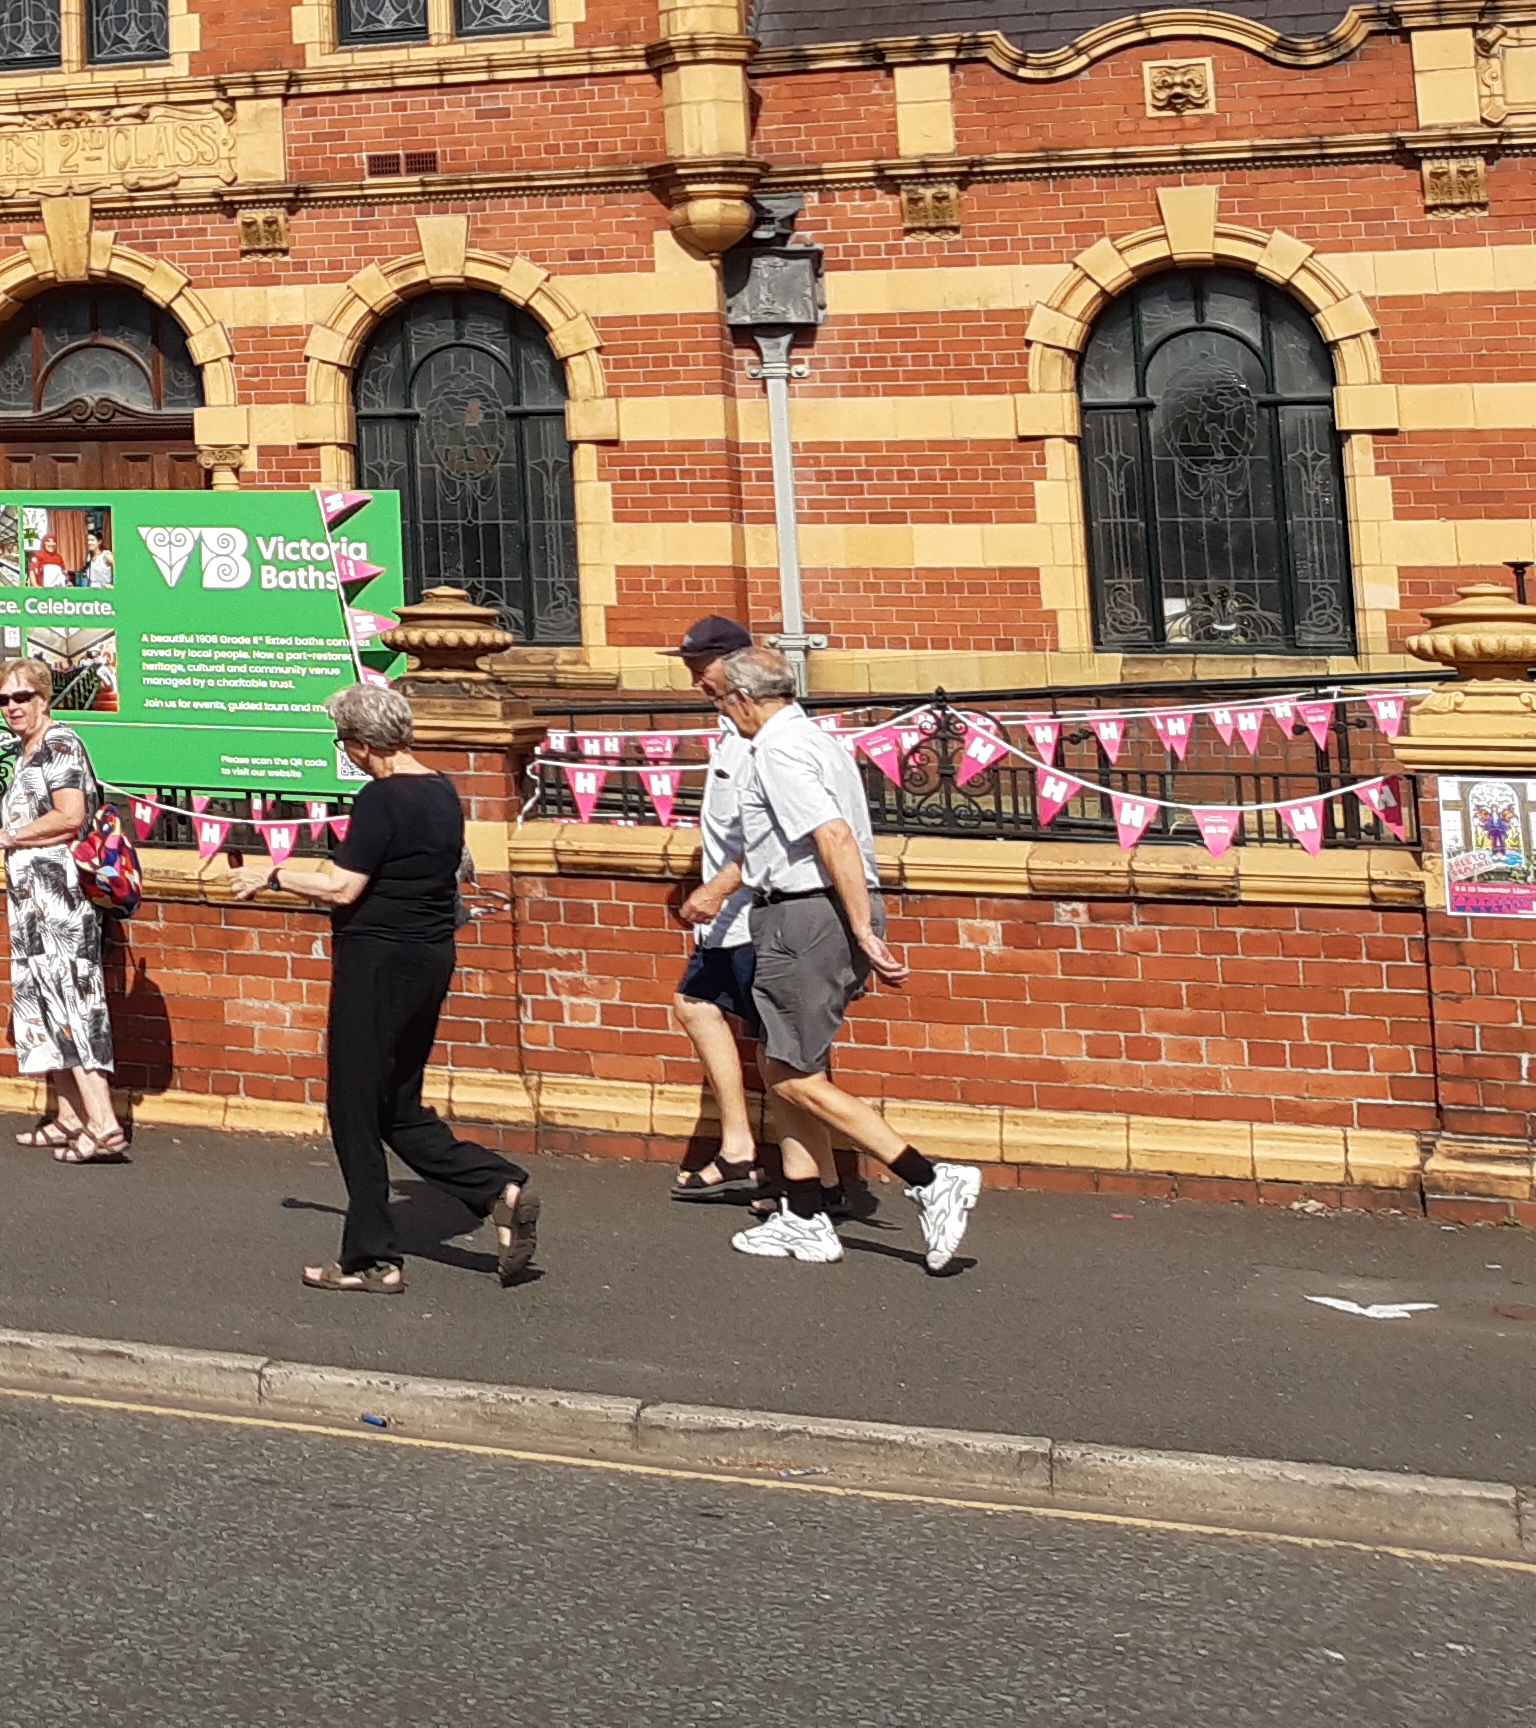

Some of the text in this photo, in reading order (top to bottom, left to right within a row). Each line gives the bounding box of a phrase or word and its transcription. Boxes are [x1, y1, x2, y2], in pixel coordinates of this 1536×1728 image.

[59, 129, 106, 173] 2ND
[110, 122, 219, 170] CLASS
[261, 565, 339, 590] Baths
[25, 598, 117, 616] Celebrate.
[354, 615, 376, 632] H
[141, 633, 149, 642] A
[150, 634, 194, 643] beautiful
[220, 635, 250, 644] Grade
[265, 636, 292, 646] listed
[295, 636, 324, 646] baths
[142, 649, 171, 658] saved
[173, 649, 186, 660] by
[188, 649, 212, 658] local
[214, 650, 250, 660] people.
[253, 650, 274, 659] Now
[142, 662, 340, 676] heritage, cultural and community venue
[142, 677, 191, 688] managed
[193, 677, 205, 688] by
[217, 678, 267, 687] charitable
[269, 680, 296, 689] trust.
[144, 698, 163, 708] Join
[178, 699, 191, 708] for
[228, 701, 262, 712] guided
[264, 702, 289, 710] tours
[291, 703, 310, 711] and
[1378, 700, 1397, 720] H
[1167, 718, 1186, 736] H
[1238, 712, 1257, 731] H
[1034, 726, 1053, 743] H
[1099, 722, 1119, 740] H
[584, 739, 600, 756] H
[604, 737, 619, 752] H
[901, 732, 919, 749] H
[966, 737, 996, 764] H
[274, 757, 288, 765] the
[304, 759, 327, 767] code
[575, 772, 596, 794] H
[650, 774, 672, 796] H
[1041, 776, 1068, 803] H
[1368, 785, 1397, 811] H
[135, 803, 151, 823] H
[1120, 802, 1144, 828] H
[1290, 806, 1318, 832] H
[201, 823, 220, 844] H
[270, 828, 289, 849] H
